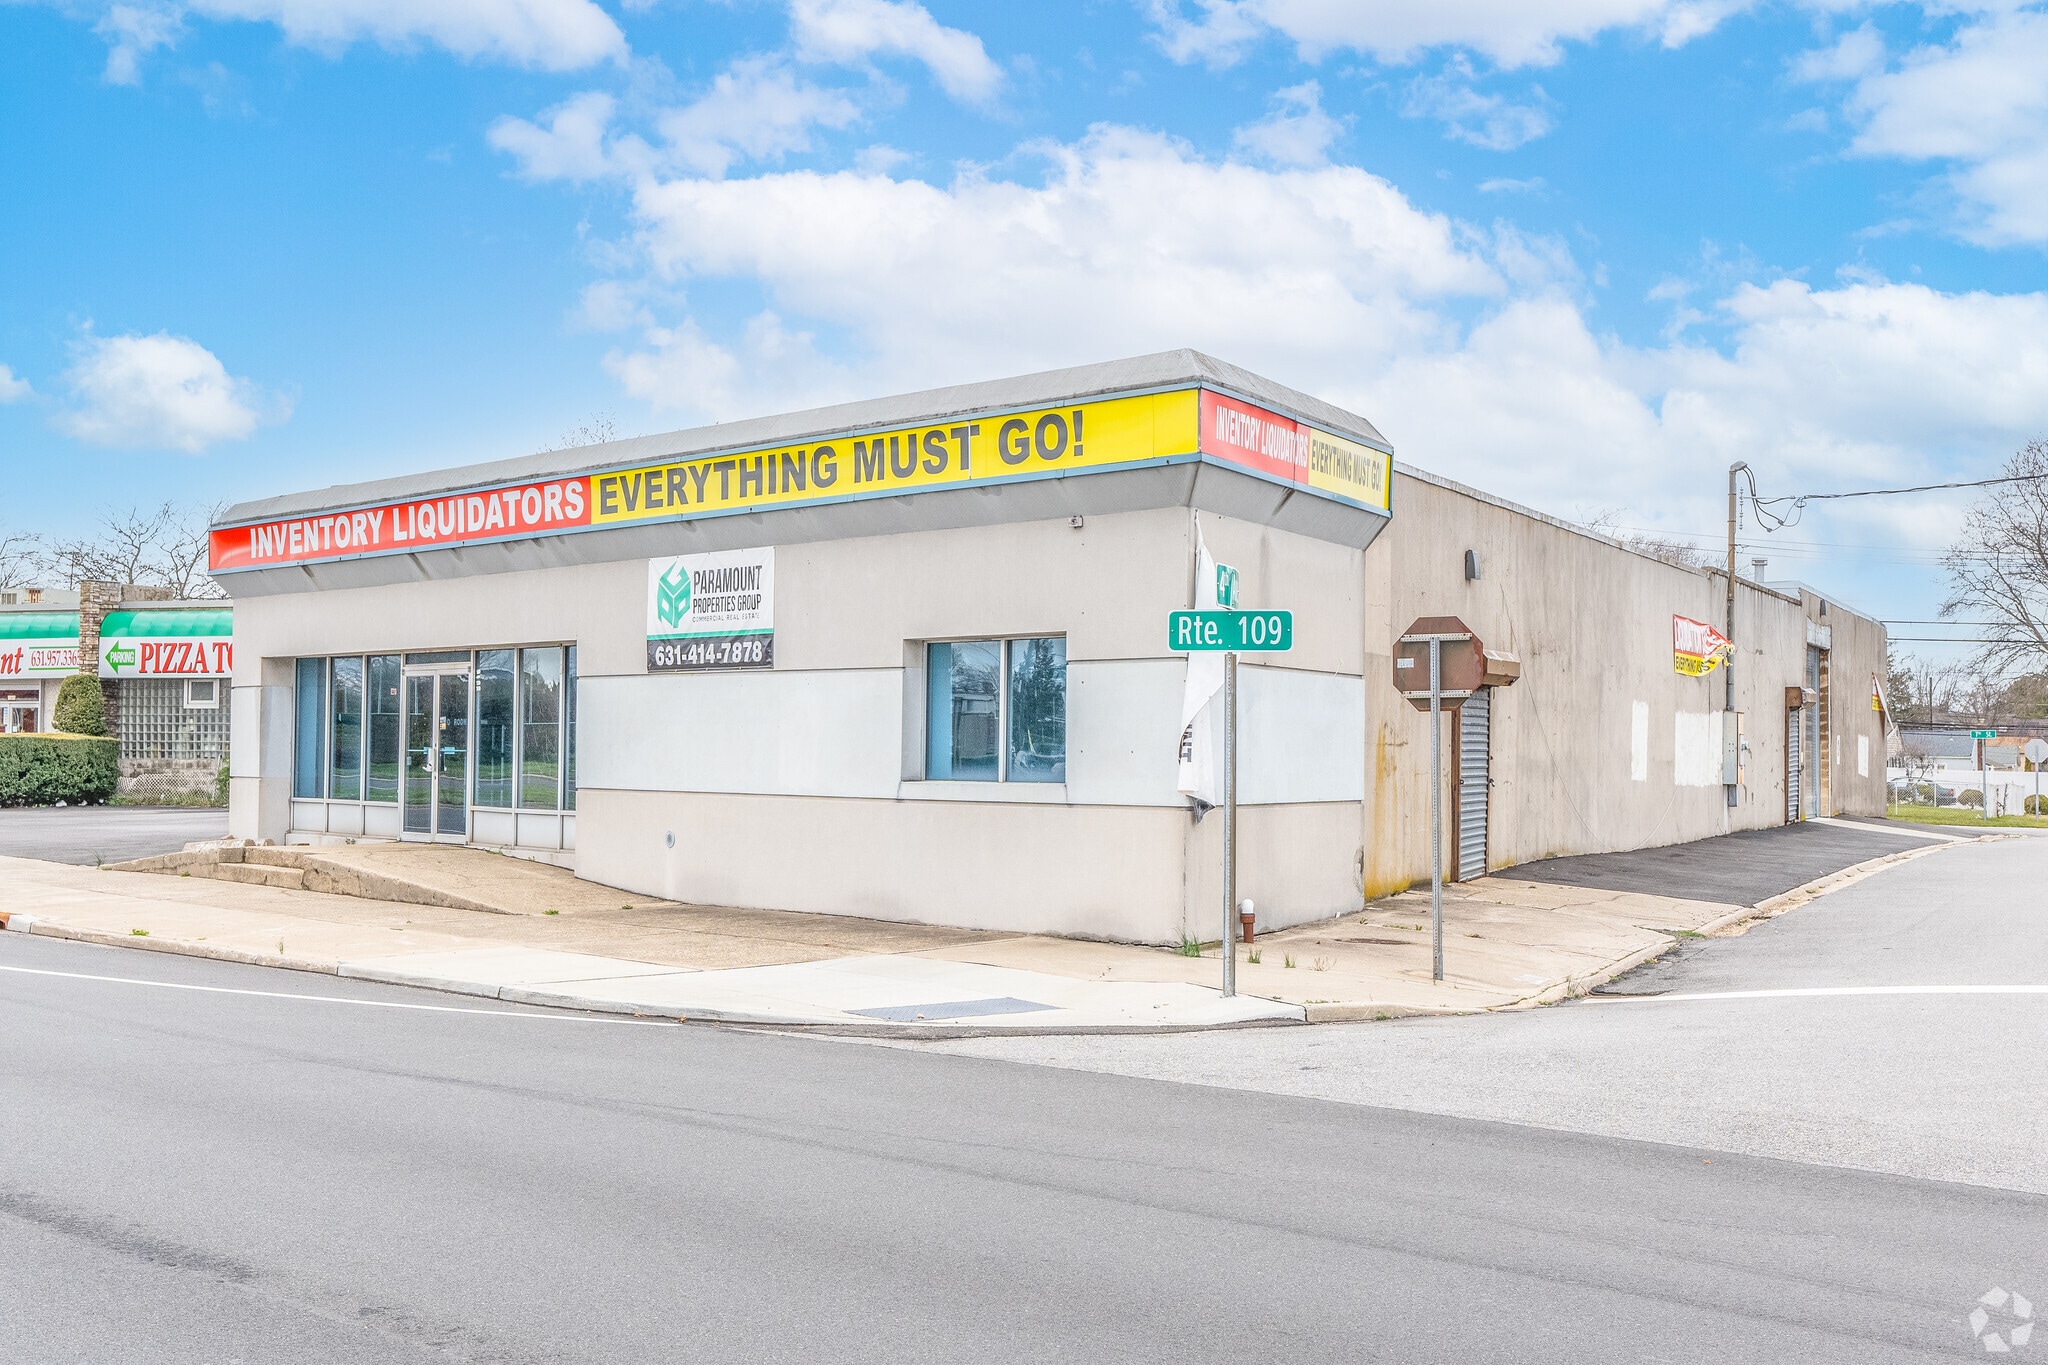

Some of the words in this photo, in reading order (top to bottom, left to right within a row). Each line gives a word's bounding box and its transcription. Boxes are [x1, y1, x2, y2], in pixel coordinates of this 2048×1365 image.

[1216, 404, 1261, 452] INVENTORY
[1261, 421, 1308, 469] LIQUIDATORS
[599, 444, 839, 516] EVERYTHING
[852, 424, 980, 484] MUST
[998, 410, 1085, 466] GO!
[1311, 438, 1352, 482] EVERYTHING
[1353, 453, 1371, 488] MUST
[1371, 460, 1383, 492] GO!
[250, 509, 385, 560] INVENTORY
[392, 480, 585, 542] LIQUIDATORS
[693, 564, 763, 595] PARAMOUNT
[692, 595, 736, 615] PROPERTIES
[737, 593, 762, 612] GROUP
[1178, 615, 1223, 645] Rte.
[1238, 615, 1282, 645] 109
[110, 651, 135, 664] PARKING
[139, 641, 210, 673] PIZZA
[655, 641, 763, 666] 631-414-7878
